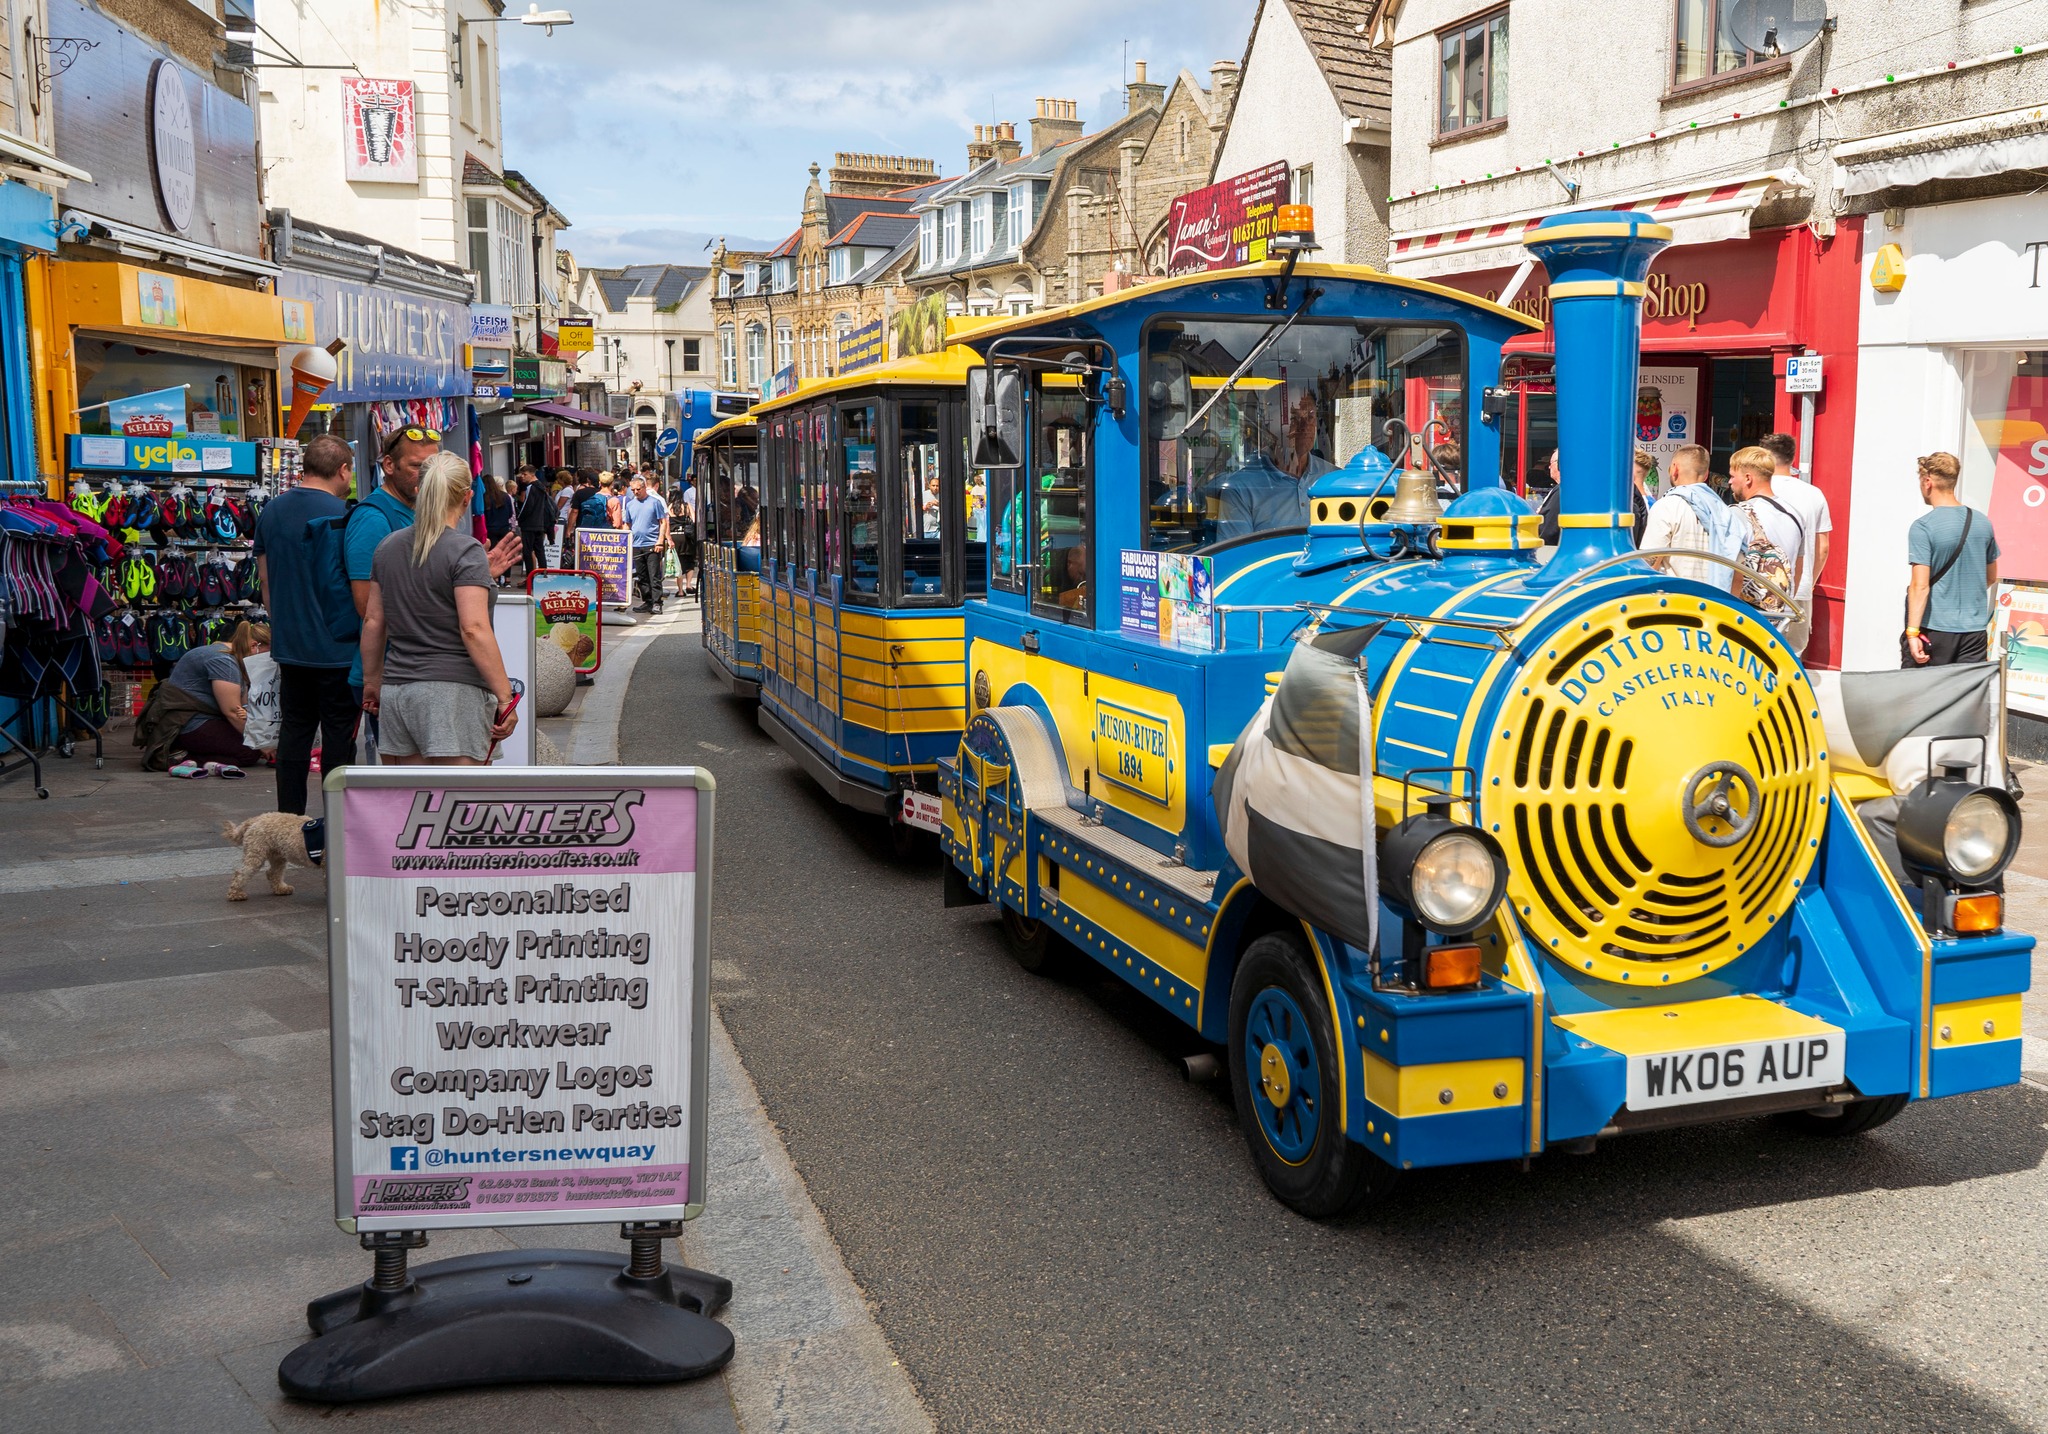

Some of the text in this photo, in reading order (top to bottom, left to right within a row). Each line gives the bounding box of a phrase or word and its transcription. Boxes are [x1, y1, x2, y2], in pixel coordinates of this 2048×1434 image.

[1246, 202, 1273, 219] Telephone
[1169, 202, 1221, 265] Zaman's
[1233, 221, 1255, 244] 01637
[1256, 217, 1270, 237] 871
[1645, 273, 1706, 328] Shop
[336, 291, 449, 392] HUNTERS
[562, 339, 592, 347] Licence
[569, 331, 583, 339] Off
[364, 365, 428, 387] NEWQUAY
[1651, 375, 1685, 385] INSIDE
[127, 423, 170, 434] KELLY'S
[134, 441, 197, 469] yello
[1640, 443, 1657, 453] SEE
[589, 533, 620, 542] WATCH
[581, 544, 627, 554] BATTERIES
[583, 555, 604, 563] FITTED
[1122, 552, 1157, 567] FABULOUS
[1122, 564, 1135, 576] FUN
[1136, 565, 1157, 580] POOLS
[544, 600, 585, 610] KELLY'S
[1559, 627, 1778, 705] DOTTO TRAINS
[1598, 663, 1747, 717] CASTELFRANCO
[1661, 690, 1715, 710] ITALY
[1119, 751, 1143, 782] 1894
[396, 789, 645, 849] HUNTERS
[922, 813, 930, 822] NOT
[445, 834, 607, 846] NEWQUAY
[392, 850, 640, 870] www.huntershoodies.co.uk
[416, 882, 630, 917] Personalised
[394, 928, 651, 970] Hoody Printing
[394, 973, 649, 1009] T-Shirt Printing
[436, 1019, 611, 1051] Workwear
[1646, 1038, 1829, 1097] WK06 AUP
[390, 1061, 653, 1100] Company Logos
[360, 1101, 682, 1144] Stag Do-Hen Parties
[424, 1144, 656, 1167] @huntersnewquay
[361, 1177, 473, 1204] HUNTERS
[530, 1177, 560, 1188] Bank
[561, 1176, 576, 1188] St,
[578, 1175, 633, 1187] Newquay,
[384, 1195, 455, 1203] NEWQUAY
[476, 1193, 513, 1204] 01637
[565, 1187, 676, 1201] huntersltd@aol.com
[359, 1201, 471, 1211] www.huntershoodies.co.uk
